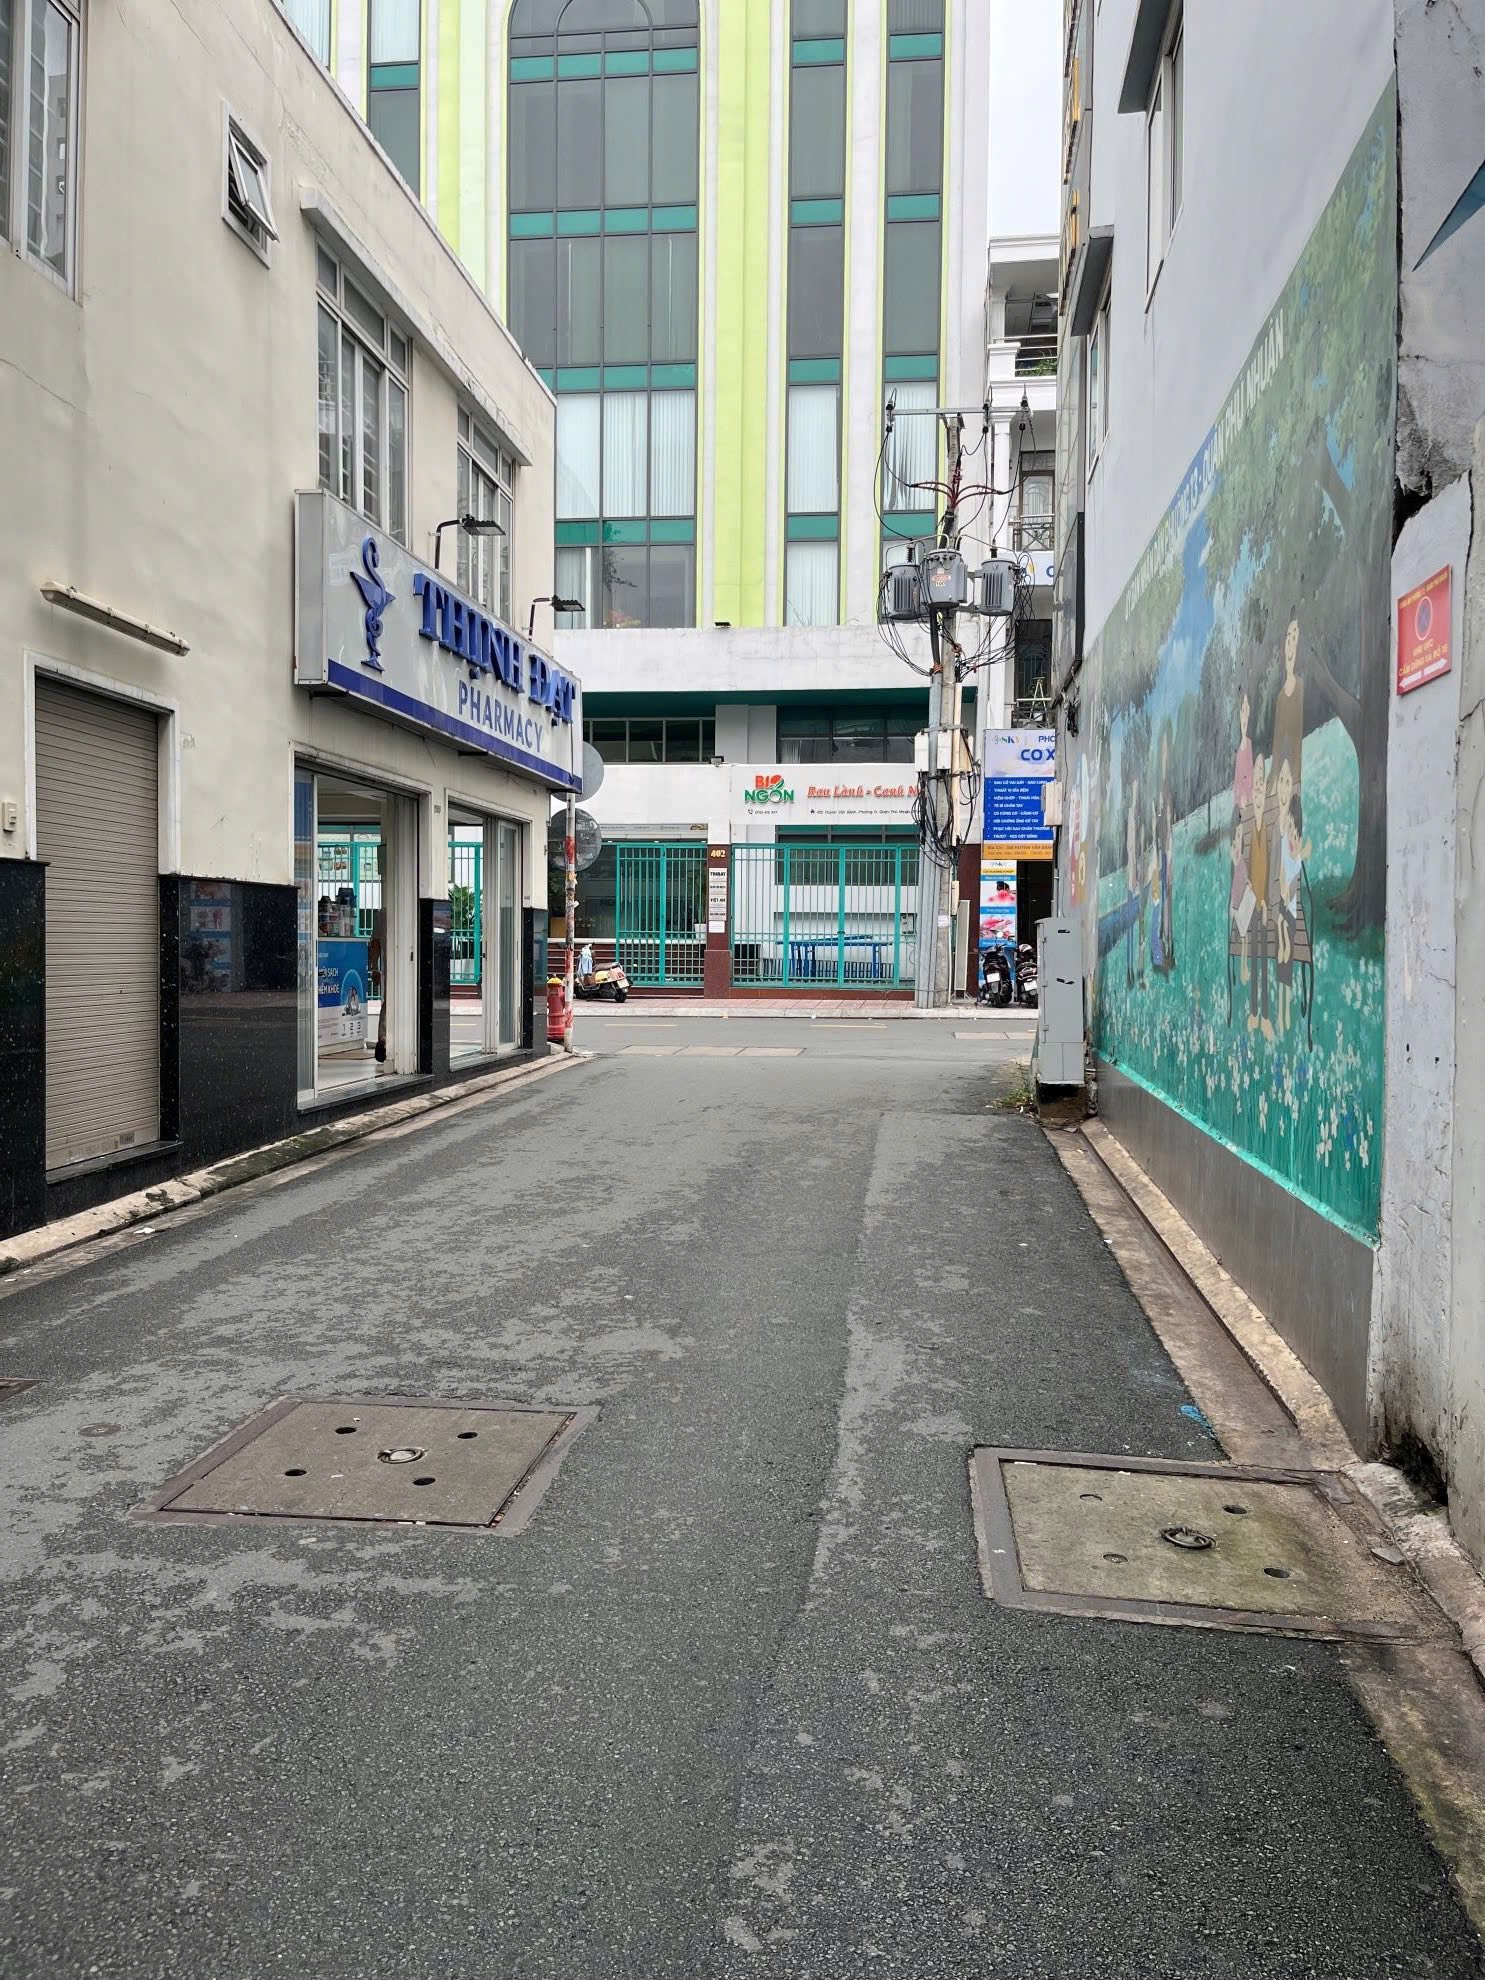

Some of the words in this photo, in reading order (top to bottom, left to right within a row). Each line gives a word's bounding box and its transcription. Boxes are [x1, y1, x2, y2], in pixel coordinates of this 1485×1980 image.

[414, 572, 525, 694] THỊNH
[528, 654, 576, 727] ĐẠT
[458, 679, 543, 754] PHARMACY
[755, 774, 784, 789] BIO
[808, 786, 830, 798] Rau
[833, 785, 864, 798] Lành
[873, 785, 904, 798] Canh
[710, 850, 726, 858] 402
